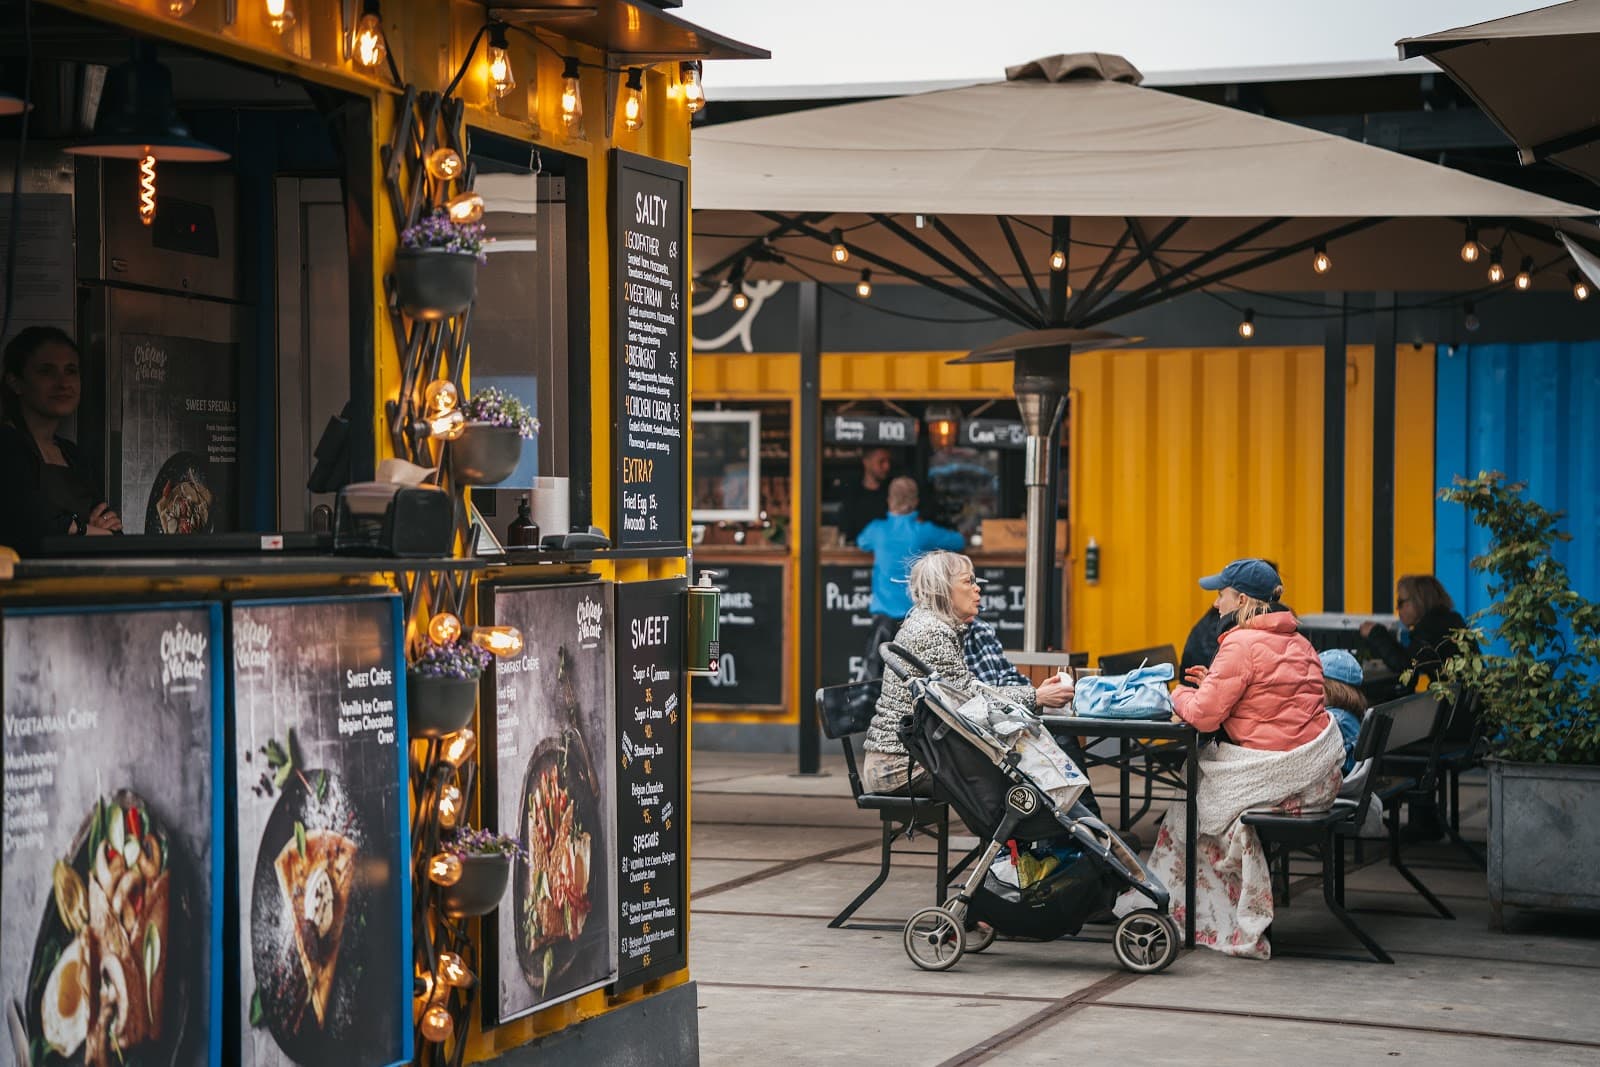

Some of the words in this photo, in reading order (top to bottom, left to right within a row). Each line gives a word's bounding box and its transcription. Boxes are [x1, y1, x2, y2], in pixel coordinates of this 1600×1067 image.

[636, 192, 668, 228] SALTY
[629, 283, 663, 308] VEGETARIAN
[629, 345, 657, 370] BREAKFAST
[185, 398, 207, 411] SWEET
[207, 399, 231, 413] SPECIAL
[629, 396, 652, 419] CHICKEN
[623, 457, 653, 484] EXTRA?
[623, 491, 637, 510] Fried
[637, 493, 647, 516] Egg
[623, 513, 646, 531] Avocado
[631, 616, 670, 650] SWEET
[346, 669, 369, 688] SWEET
[633, 664, 646, 685] Sugar
[646, 666, 652, 679] &
[341, 699, 362, 717] Vanilla
[362, 699, 373, 714] Ice
[372, 697, 393, 714] Cream
[634, 705, 647, 725] Sugar
[649, 705, 663, 720] Lemon
[338, 716, 363, 736] Belgian
[362, 712, 394, 731] Chocolate
[377, 728, 394, 745] Oreo
[655, 742, 664, 756] Jam
[631, 782, 646, 799] Belgian
[645, 780, 664, 796] Chocolate
